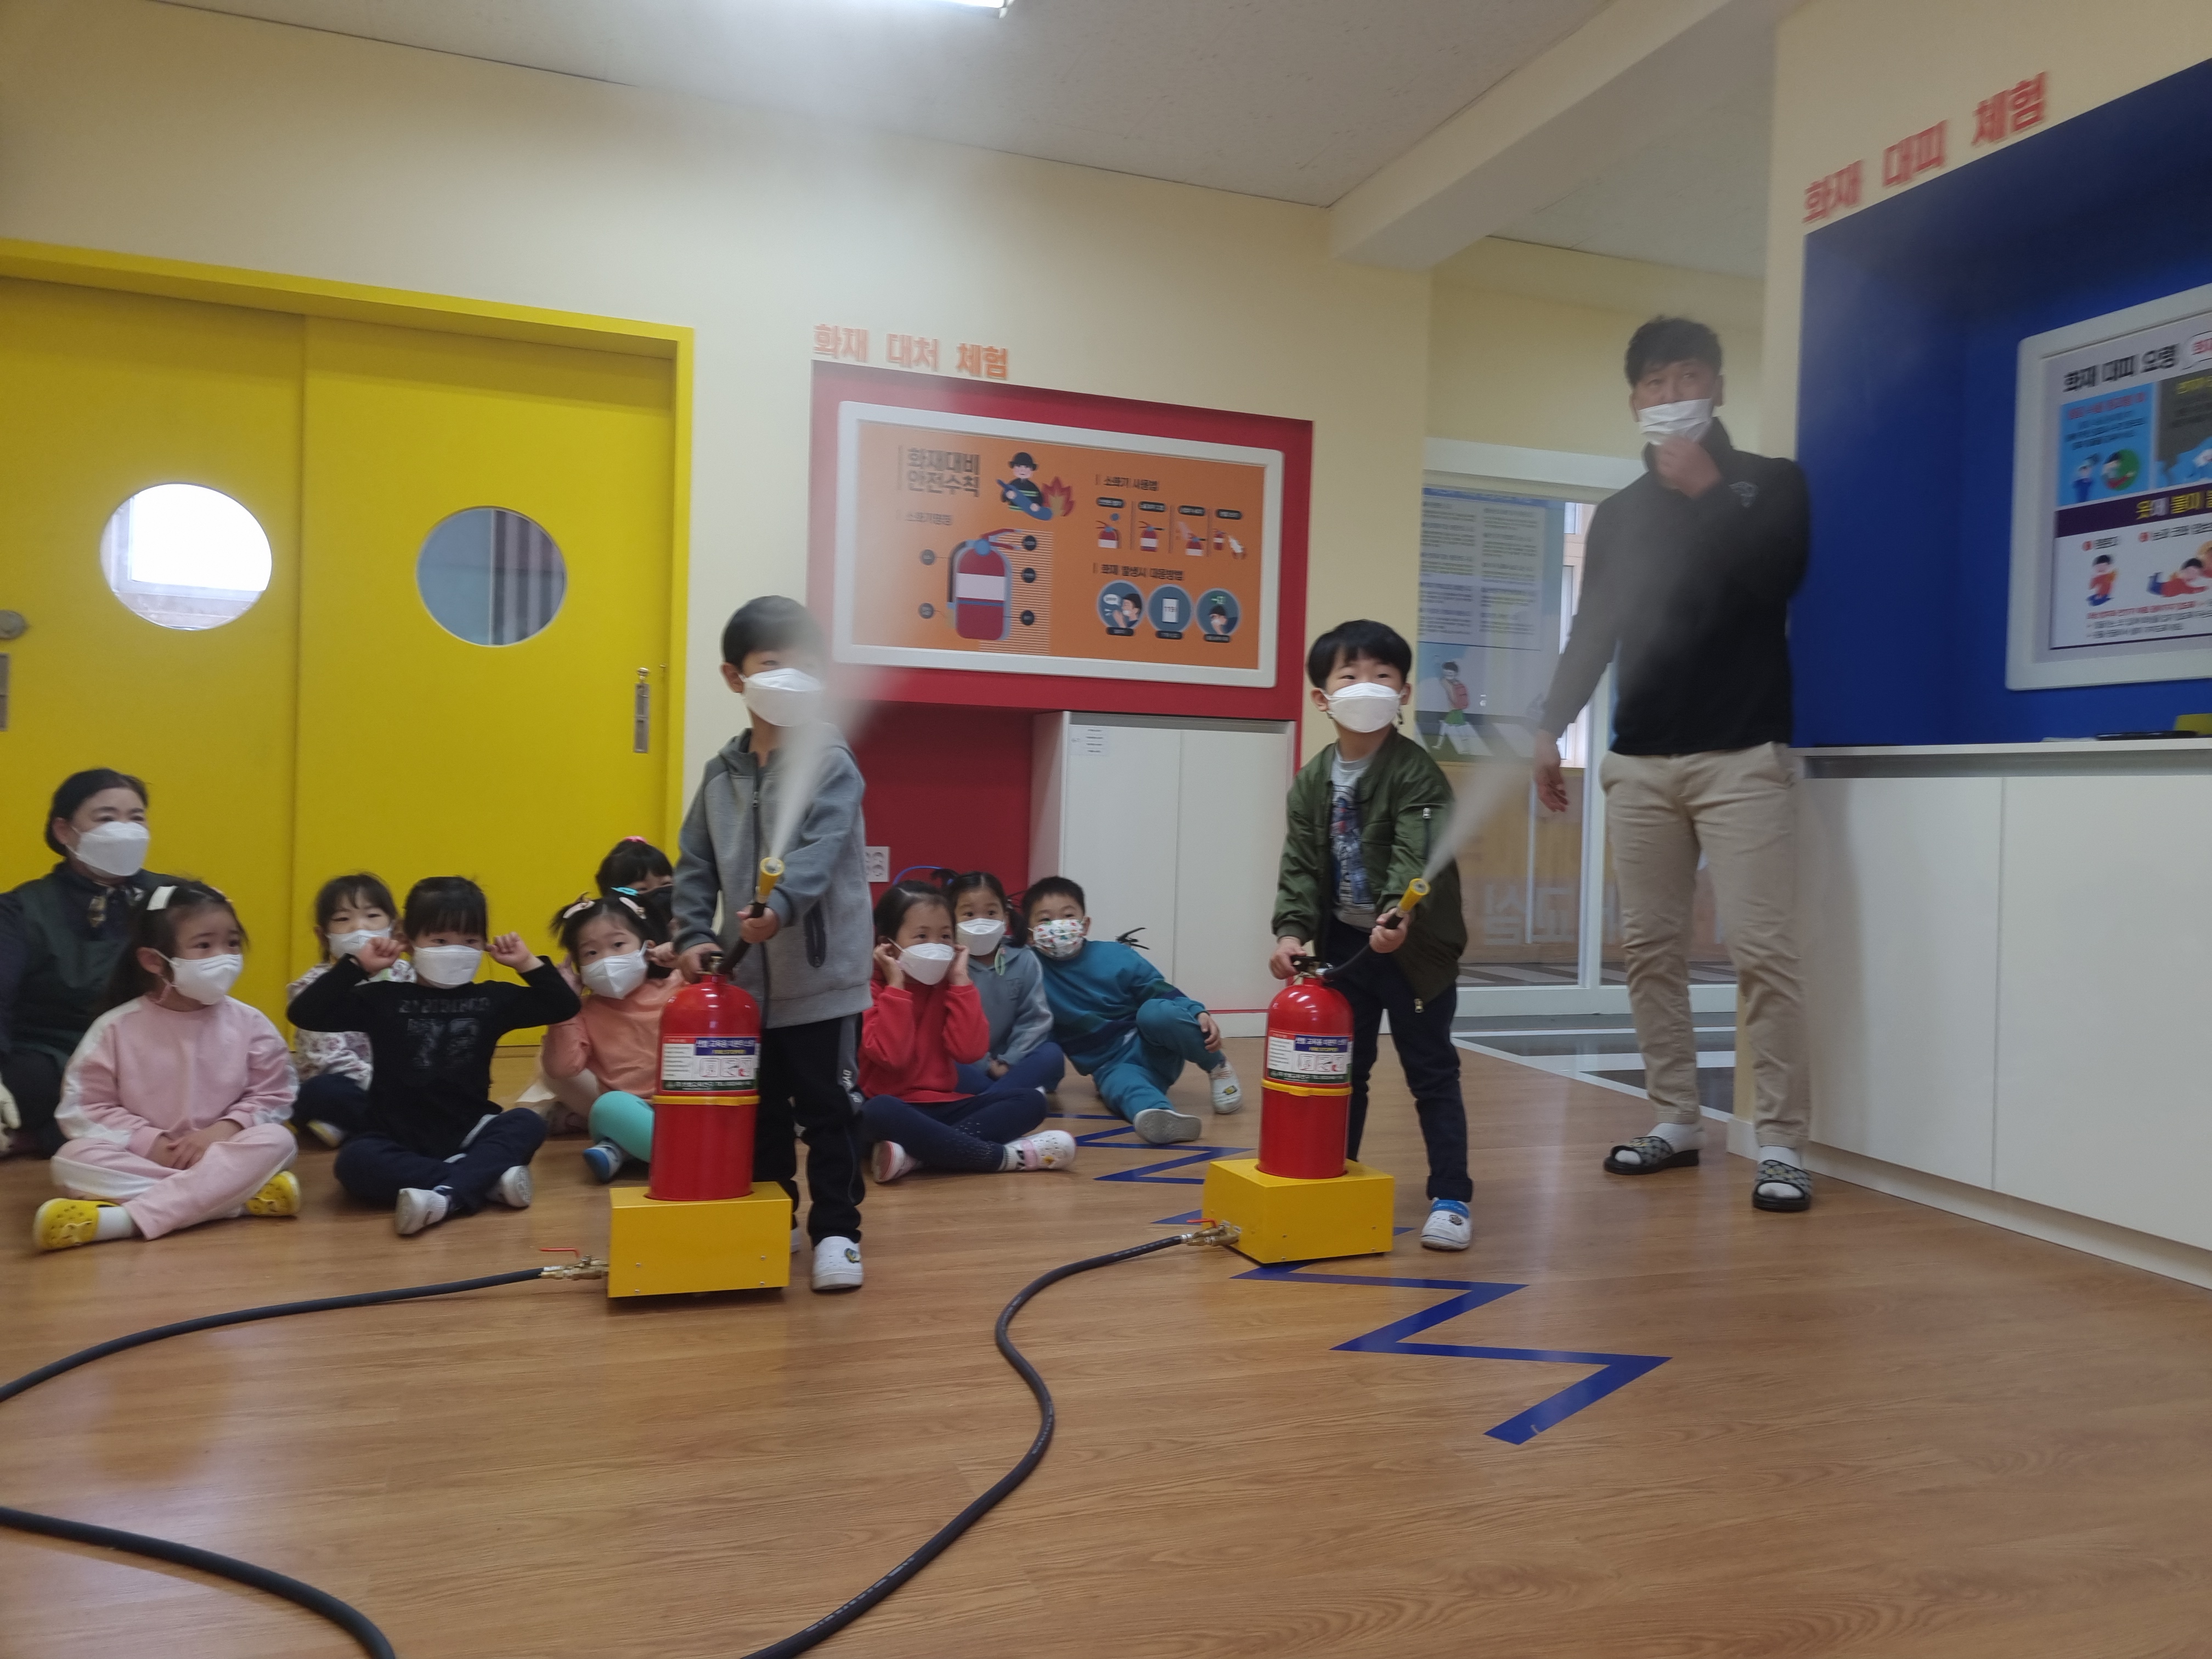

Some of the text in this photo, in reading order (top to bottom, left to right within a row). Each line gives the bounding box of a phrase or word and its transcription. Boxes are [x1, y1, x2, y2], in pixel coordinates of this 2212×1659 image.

[1802, 71, 2047, 224] 화재 대피 체험
[813, 323, 1008, 380] 화재 대처 체험
[2062, 365, 2097, 393] 화재
[2101, 354, 2136, 382] 대피
[2141, 343, 2179, 373] 요령
[907, 447, 980, 476] 화재대비
[908, 470, 980, 497] 안전수칙
